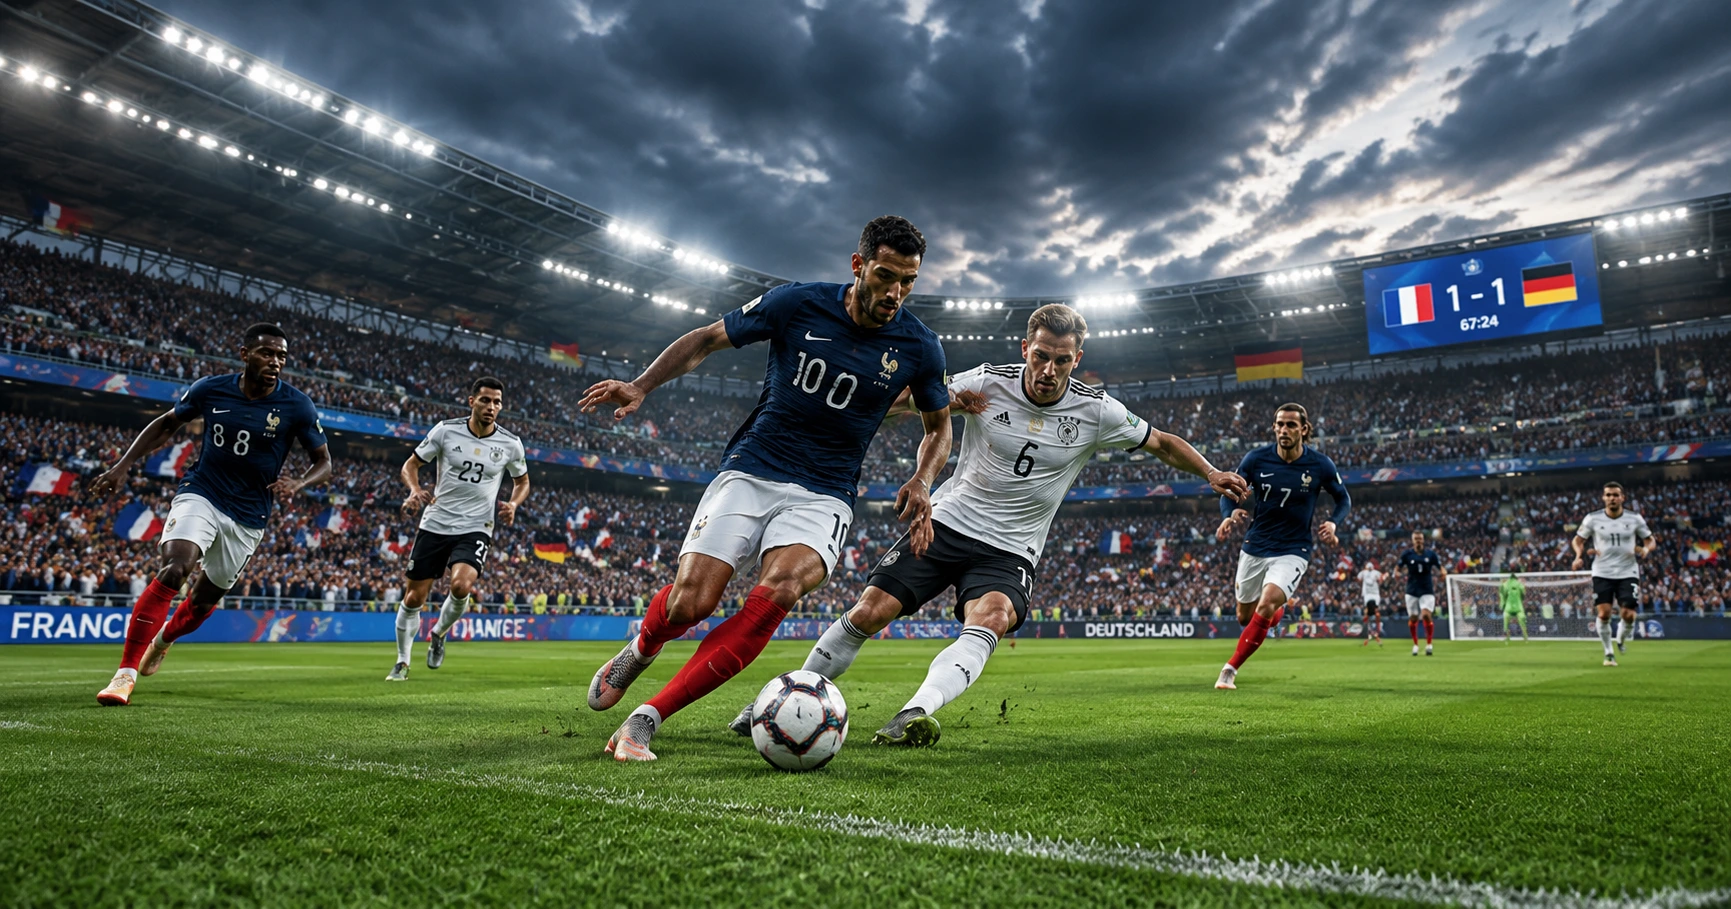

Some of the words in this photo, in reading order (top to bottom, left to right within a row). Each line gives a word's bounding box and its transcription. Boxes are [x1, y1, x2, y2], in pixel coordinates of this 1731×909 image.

[1446, 284, 1461, 312] 1
[1491, 277, 1506, 306] 1
[1459, 314, 1499, 332] 67:24
[1013, 440, 1039, 478] 6
[457, 460, 485, 484] 23
[1610, 533, 1621, 547] 11
[1085, 623, 1195, 638] DEUTSCHLAND
